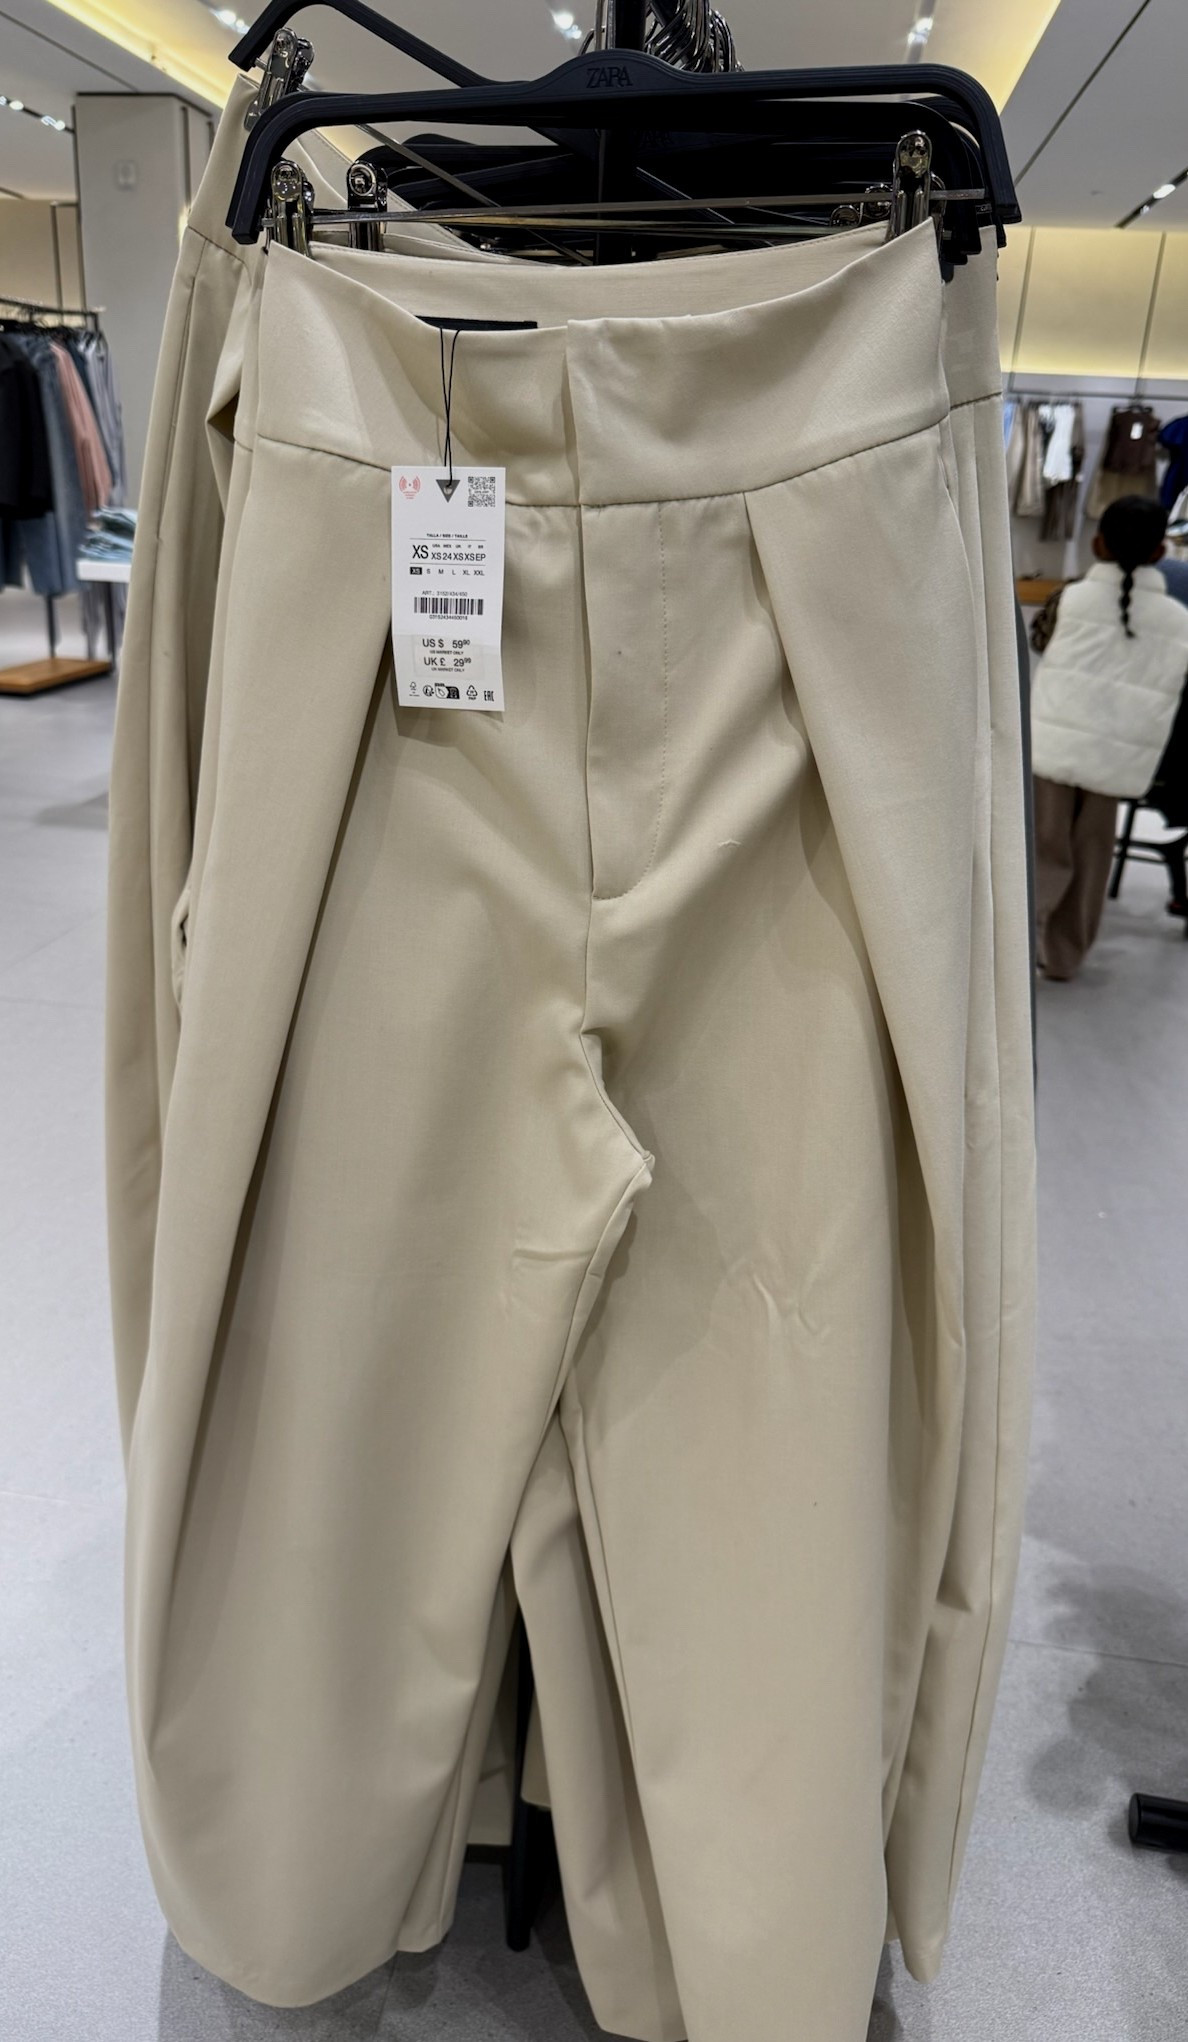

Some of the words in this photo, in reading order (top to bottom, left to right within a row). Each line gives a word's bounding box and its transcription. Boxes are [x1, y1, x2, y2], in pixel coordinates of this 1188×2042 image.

[586, 65, 634, 89] ZARA
[412, 544, 429, 559] XS
[431, 552, 442, 561] XS
[442, 552, 452, 561] 24
[453, 553, 464, 561] XS
[464, 553, 475, 561] XS
[475, 553, 486, 561] EP
[422, 638, 436, 648] US
[438, 638, 444, 648] $
[423, 657, 438, 666] UK
[440, 657, 446, 667] £
